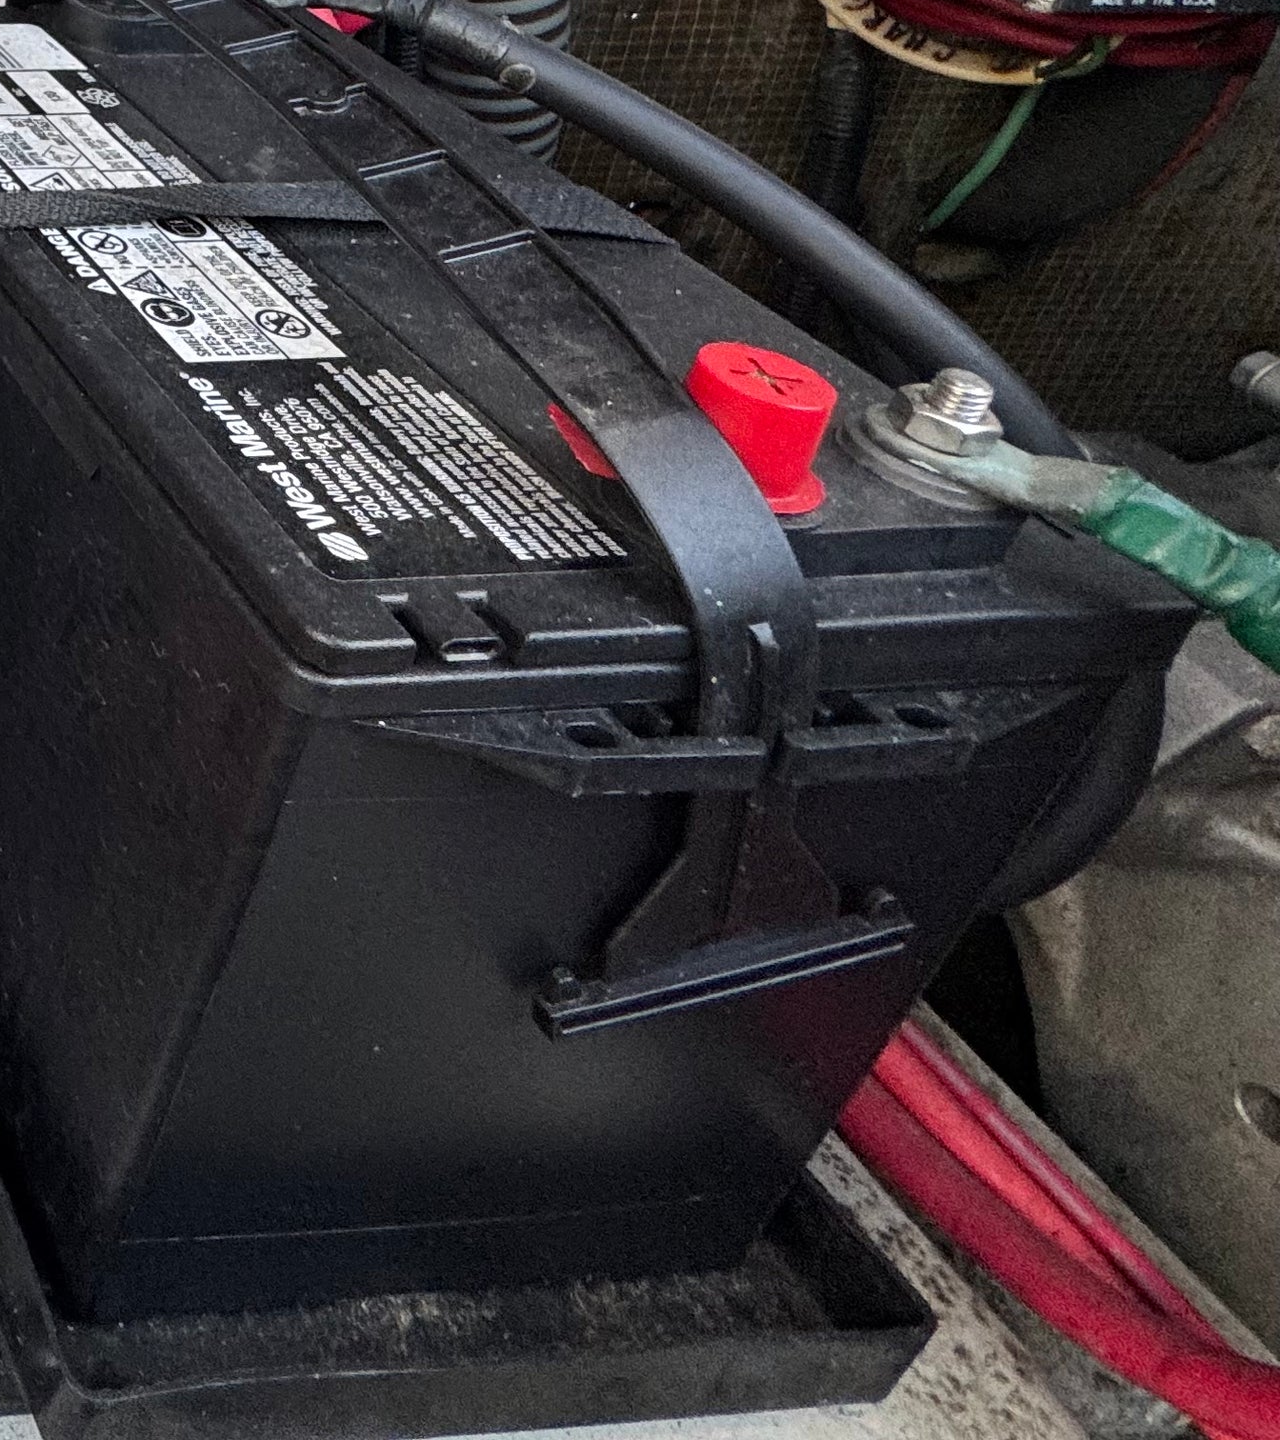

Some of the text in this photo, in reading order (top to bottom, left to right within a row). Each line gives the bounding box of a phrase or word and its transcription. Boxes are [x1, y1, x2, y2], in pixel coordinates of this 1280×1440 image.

[172, 285, 250, 355] EXPLOSIVE GASES
[174, 329, 212, 357] SHIELD
[199, 332, 232, 356] EYES.
[218, 316, 250, 339] CAUSE
[242, 340, 266, 355] CAN
[184, 376, 335, 529] West Marine
[237, 386, 382, 536] West Marine Products, Inc.
[282, 397, 412, 521] Watsonville, CA 95076
[301, 435, 389, 518] 500 Westridge
[306, 397, 434, 518] www.westmarine.com
